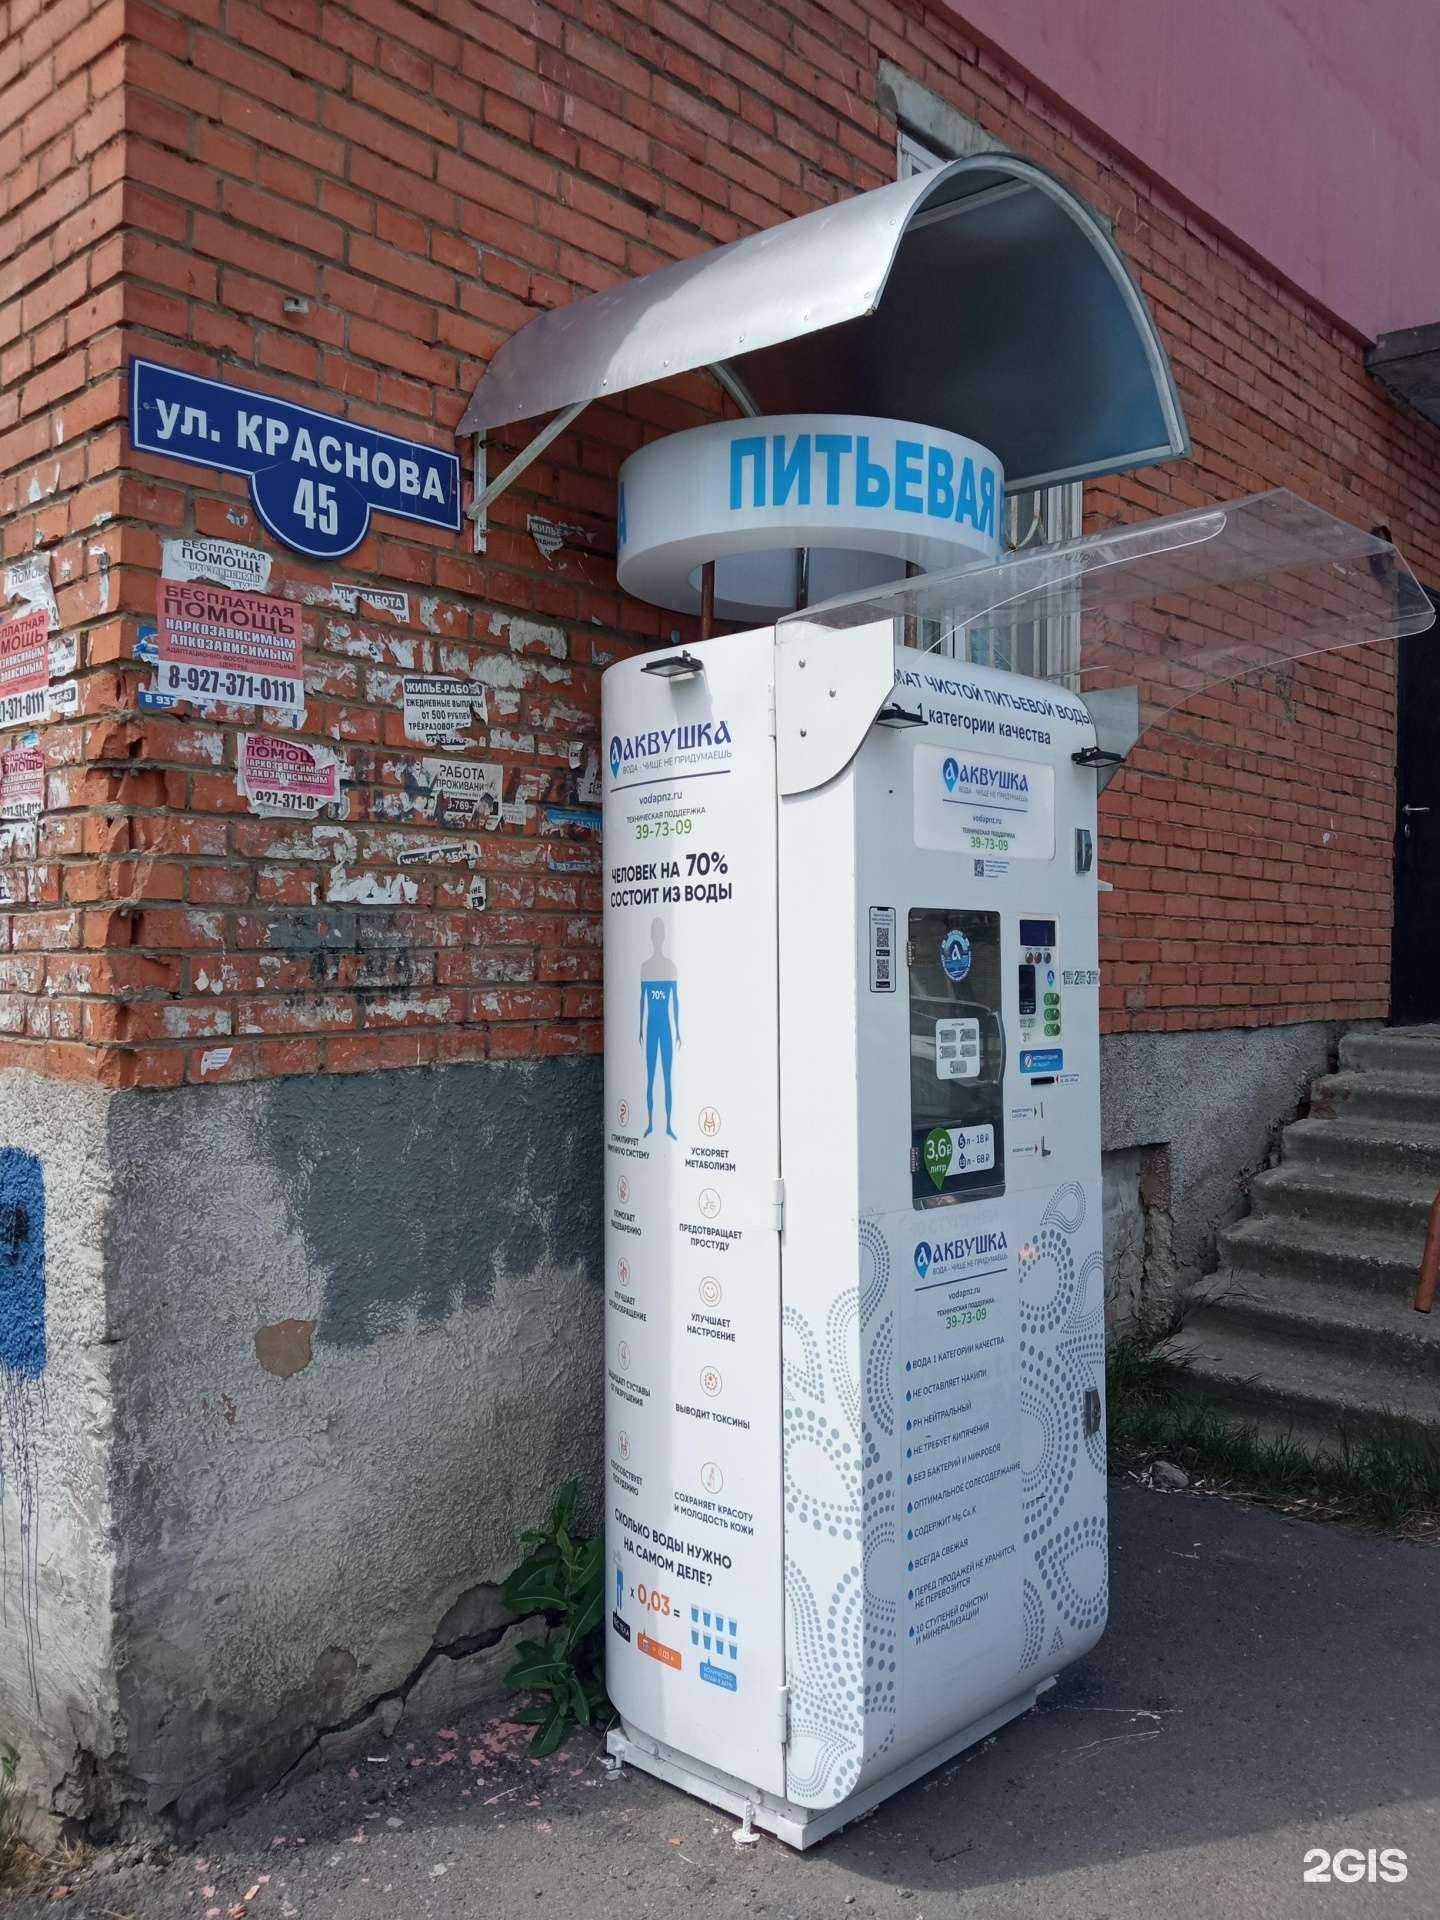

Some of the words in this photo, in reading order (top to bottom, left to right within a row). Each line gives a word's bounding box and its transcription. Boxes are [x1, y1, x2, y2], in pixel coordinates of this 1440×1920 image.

[155, 398, 220, 442] ул.
[237, 410, 446, 504] КРАСНОВА
[729, 433, 995, 538] ПИТЬЕВАЯ
[293, 478, 339, 536] 45
[164, 598, 295, 635] ПОМОЩЬ
[166, 585, 295, 618] БЕСПЛАТНАЯ
[165, 618, 296, 649] НАРКОЗАВИСИМЫМ
[170, 633, 294, 662] АЛКОЗАВИСИМЫМ
[168, 665, 296, 703] 8-927-371-0111
[431, 709, 446, 720] 500
[923, 675, 983, 703] ЧИСТОЙ
[984, 688, 1054, 719] ПИТЬЕВОЙ
[1055, 704, 1093, 726] ВОДЫ
[623, 720, 732, 760] АКВУШКА
[928, 708, 996, 735] категории
[999, 722, 1051, 745] качества
[674, 749, 732, 764] ПРИДУМАЕШЬ
[439, 764, 485, 781] РАБОТА
[959, 764, 1029, 792] АКВУШКА
[639, 791, 683, 805] vodapnz.ru
[664, 806, 706, 819] ПОДДЕРЖКА
[635, 818, 692, 840] 39-73-09
[970, 836, 1009, 851] 39-73-09
[611, 862, 657, 884] ЧЕЛОВЕК
[661, 861, 681, 879] НА
[685, 851, 728, 877] 70%
[610, 886, 659, 908] СОСТОИТ
[662, 885, 681, 903] ИЗ
[685, 882, 732, 903] ВОДЫ
[651, 990, 666, 1000] 70%
[684, 1159, 737, 1172] МЕТАБОЛИЗМ
[691, 1147, 729, 1159] УСКОРЯЕТ
[679, 1223, 743, 1240] ПРЕДОТВРАЩАЕТ
[690, 1237, 730, 1252] ПРОСТУДУ
[933, 1231, 1008, 1263] АКВУШКА
[686, 1325, 736, 1342] НАСТРОЕНИЕ
[691, 1312, 731, 1328] УЛУЧШАЕТ
[945, 1308, 987, 1329] 39-73-09
[912, 1357, 931, 1369] ВОДА
[938, 1344, 974, 1361] КАТЕГОРИИ
[974, 1336, 1005, 1352] КАЧЕСТВА
[912, 1389, 922, 1398] НЕ
[923, 1377, 960, 1395] ОСТАВЛЯЕТ
[961, 1368, 987, 1383] НАКИПИ
[675, 1403, 711, 1421] ВЫВОДИТ
[712, 1411, 750, 1430] ТОКСИНЫ
[924, 1399, 972, 1425] НЕЙТРАЛЬНЫЙ
[913, 1445, 923, 1455] НЕ
[924, 1435, 952, 1451] ТРЕБУЕТ
[952, 1422, 990, 1441] КИПЯЧЕНИЯ
[913, 1470, 926, 1482] БЕЗ
[927, 1456, 961, 1477] БАКТЕРИЙ
[967, 1443, 1001, 1463] МИКРОБОВ
[913, 1485, 964, 1511] ОПТИМАЛЬНОЕ
[965, 1461, 1021, 1489] СОЛЕСОДЕРЖАНИЕ
[674, 1491, 716, 1512] СОХРАНЯЕТ
[718, 1504, 753, 1522] КРАСОТУ
[680, 1505, 729, 1529] МОЛОДОСТЬ
[730, 1521, 754, 1537] КОЖИ
[614, 1508, 650, 1540] СКОЛЬКО
[652, 1529, 684, 1554] ВОДЫ
[687, 1542, 732, 1570] НУЖНО
[914, 1517, 951, 1538] СОДЕРЖИТ
[623, 1537, 635, 1555] НА
[636, 1546, 674, 1573] САМОМ
[676, 1562, 713, 1587] ДЕЛЕ?
[914, 1550, 940, 1569] ВСЕГДА
[941, 1537, 969, 1557] СВЕЖАЯ
[914, 1582, 937, 1598] ПЕРЕД
[937, 1565, 974, 1587] ПРОДАЖЕЙ
[975, 1559, 984, 1570] НЕ
[915, 1597, 925, 1609] НЕ
[925, 1576, 971, 1605] ПЕРЕВОЗИТСЯ
[637, 1583, 671, 1616] 0,03
[916, 1622, 925, 1633] 10
[925, 1606, 959, 1629] СТУПЕНЕЙ
[959, 1592, 989, 1613] ОЧИСТКИ
[922, 1607, 980, 1642] МИНЕРАЛИЗАЦИИ
